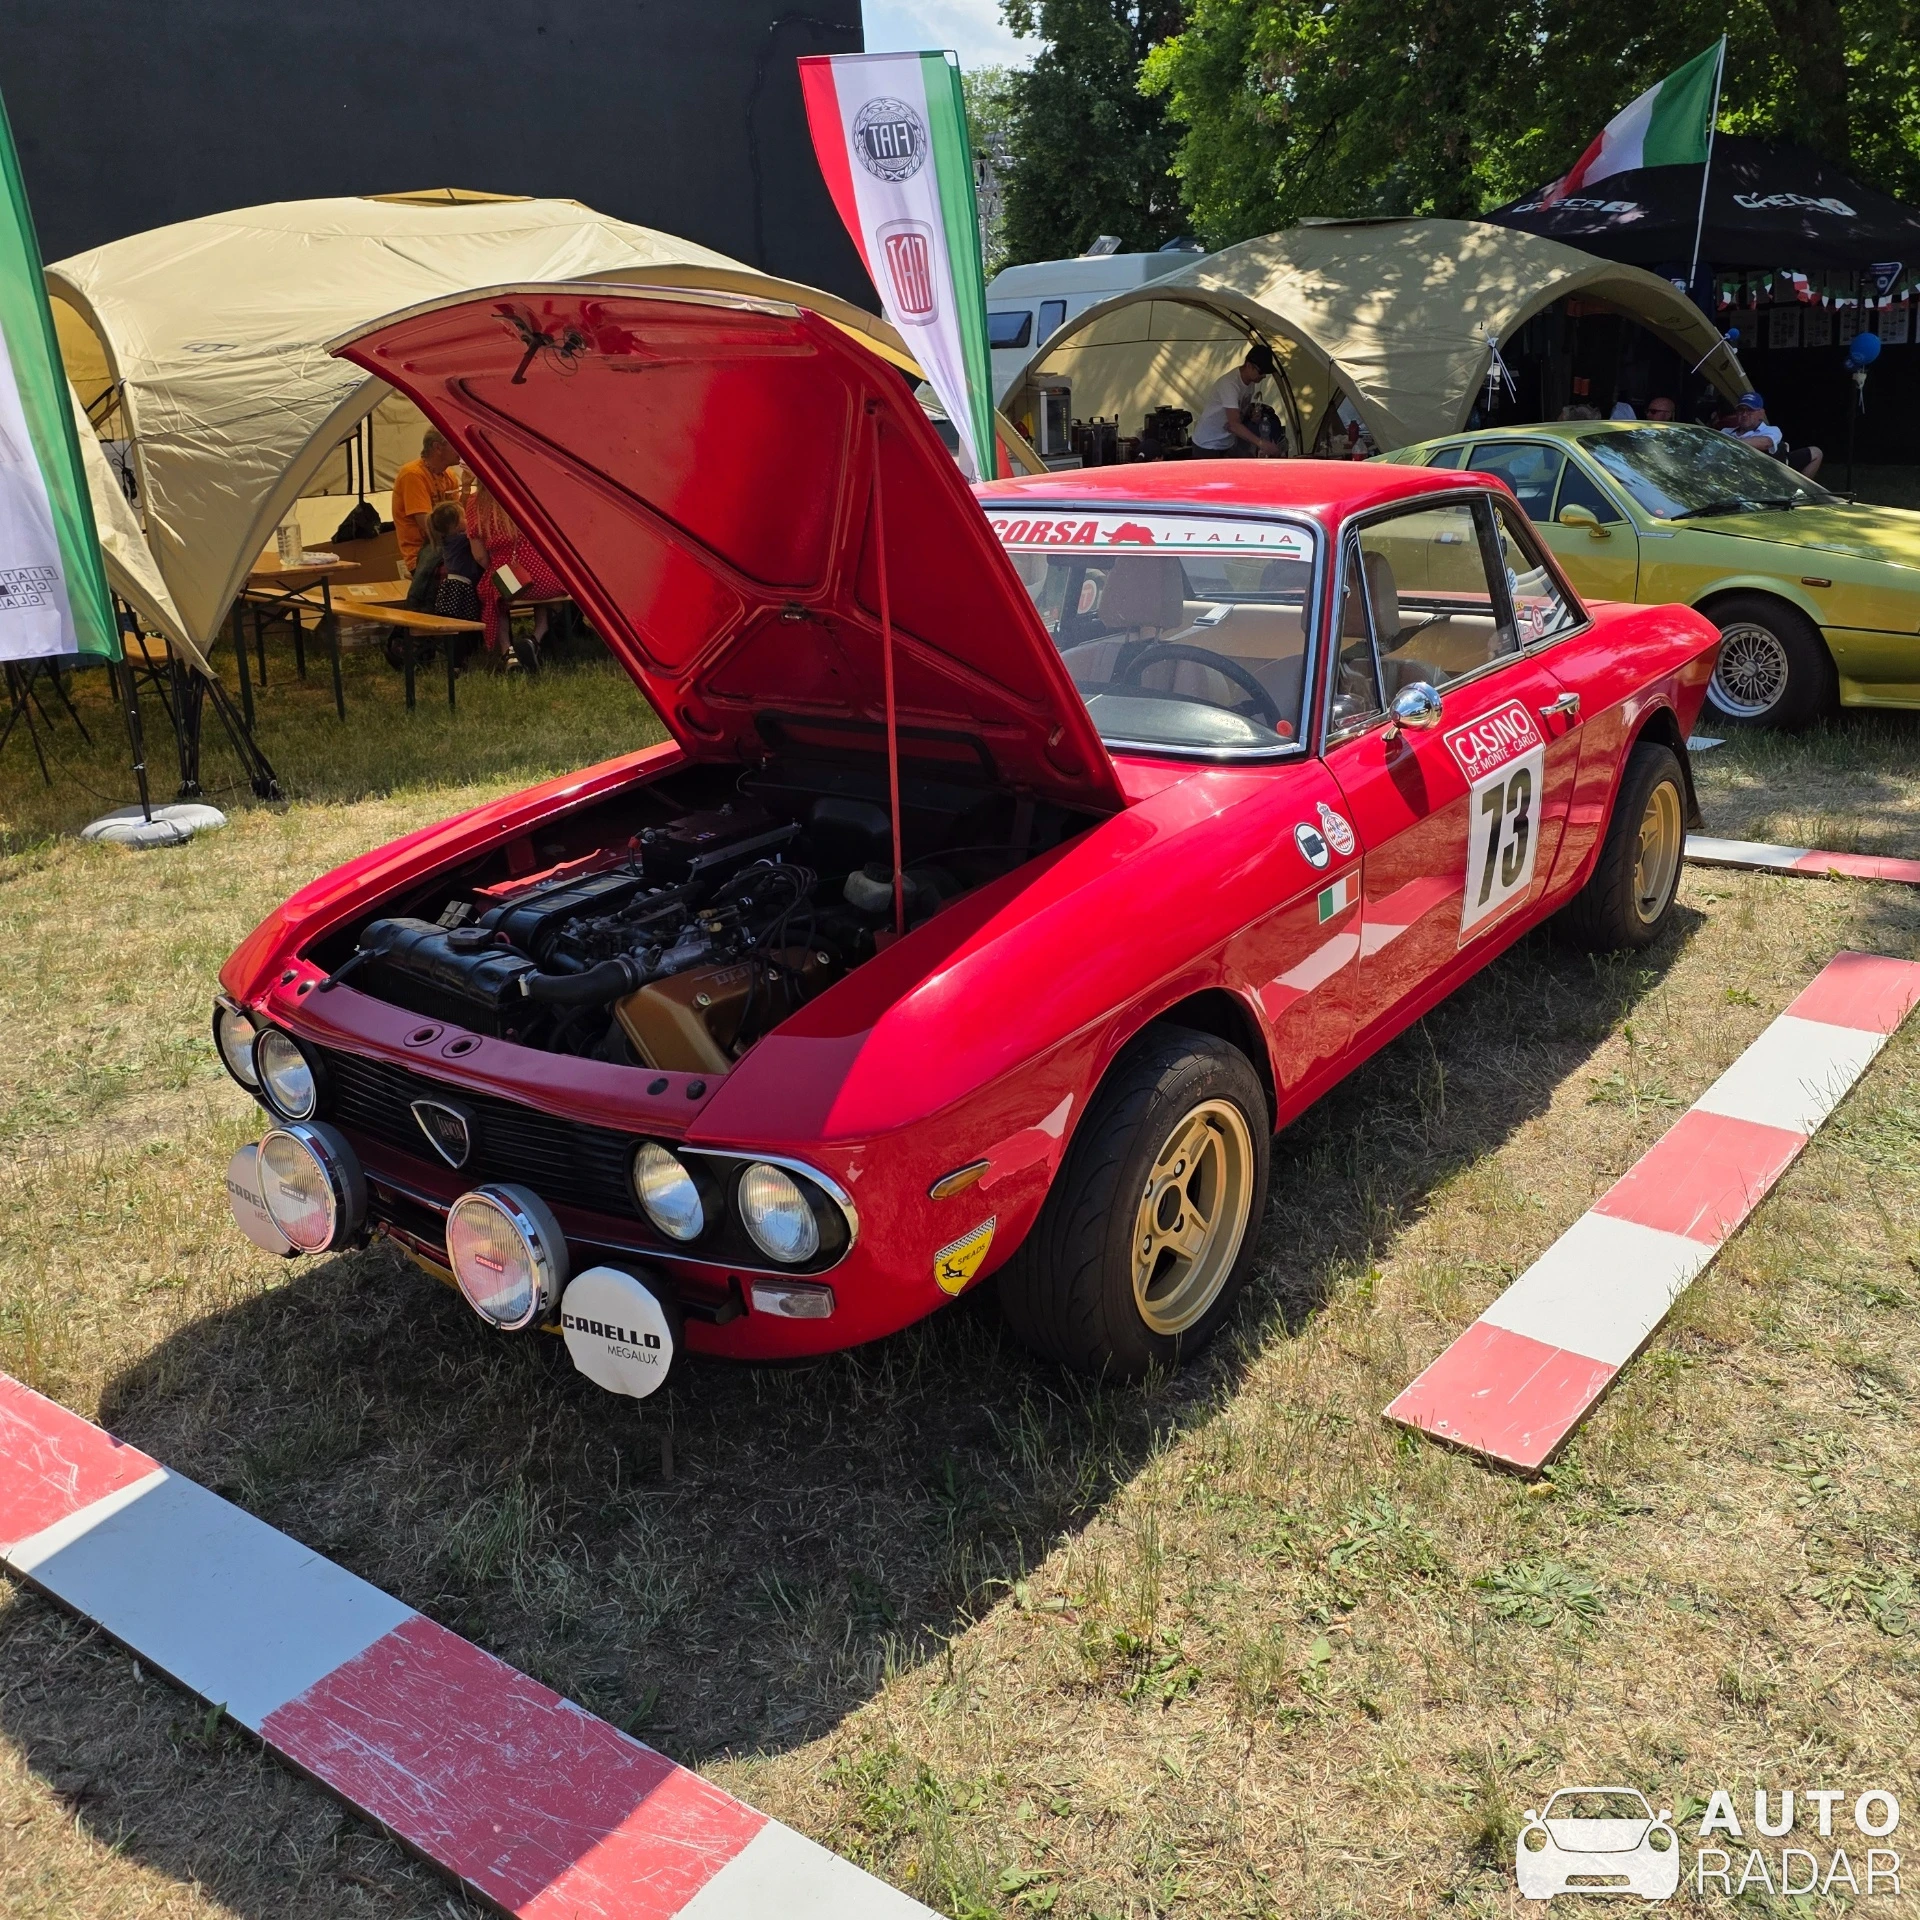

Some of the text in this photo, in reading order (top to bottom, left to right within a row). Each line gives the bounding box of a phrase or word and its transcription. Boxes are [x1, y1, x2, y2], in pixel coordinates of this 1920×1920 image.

[990, 519, 1293, 545] CORSA ITALIA
[1455, 708, 1530, 765] CASINO
[1467, 762, 1482, 778] DE
[1480, 746, 1510, 771] MONTE
[1513, 731, 1537, 752] CARLO
[1477, 767, 1532, 908] 73
[476, 1256, 503, 1272] CARELLO
[562, 1313, 661, 1350] CARELLO
[607, 1344, 659, 1366] MEGALUX
